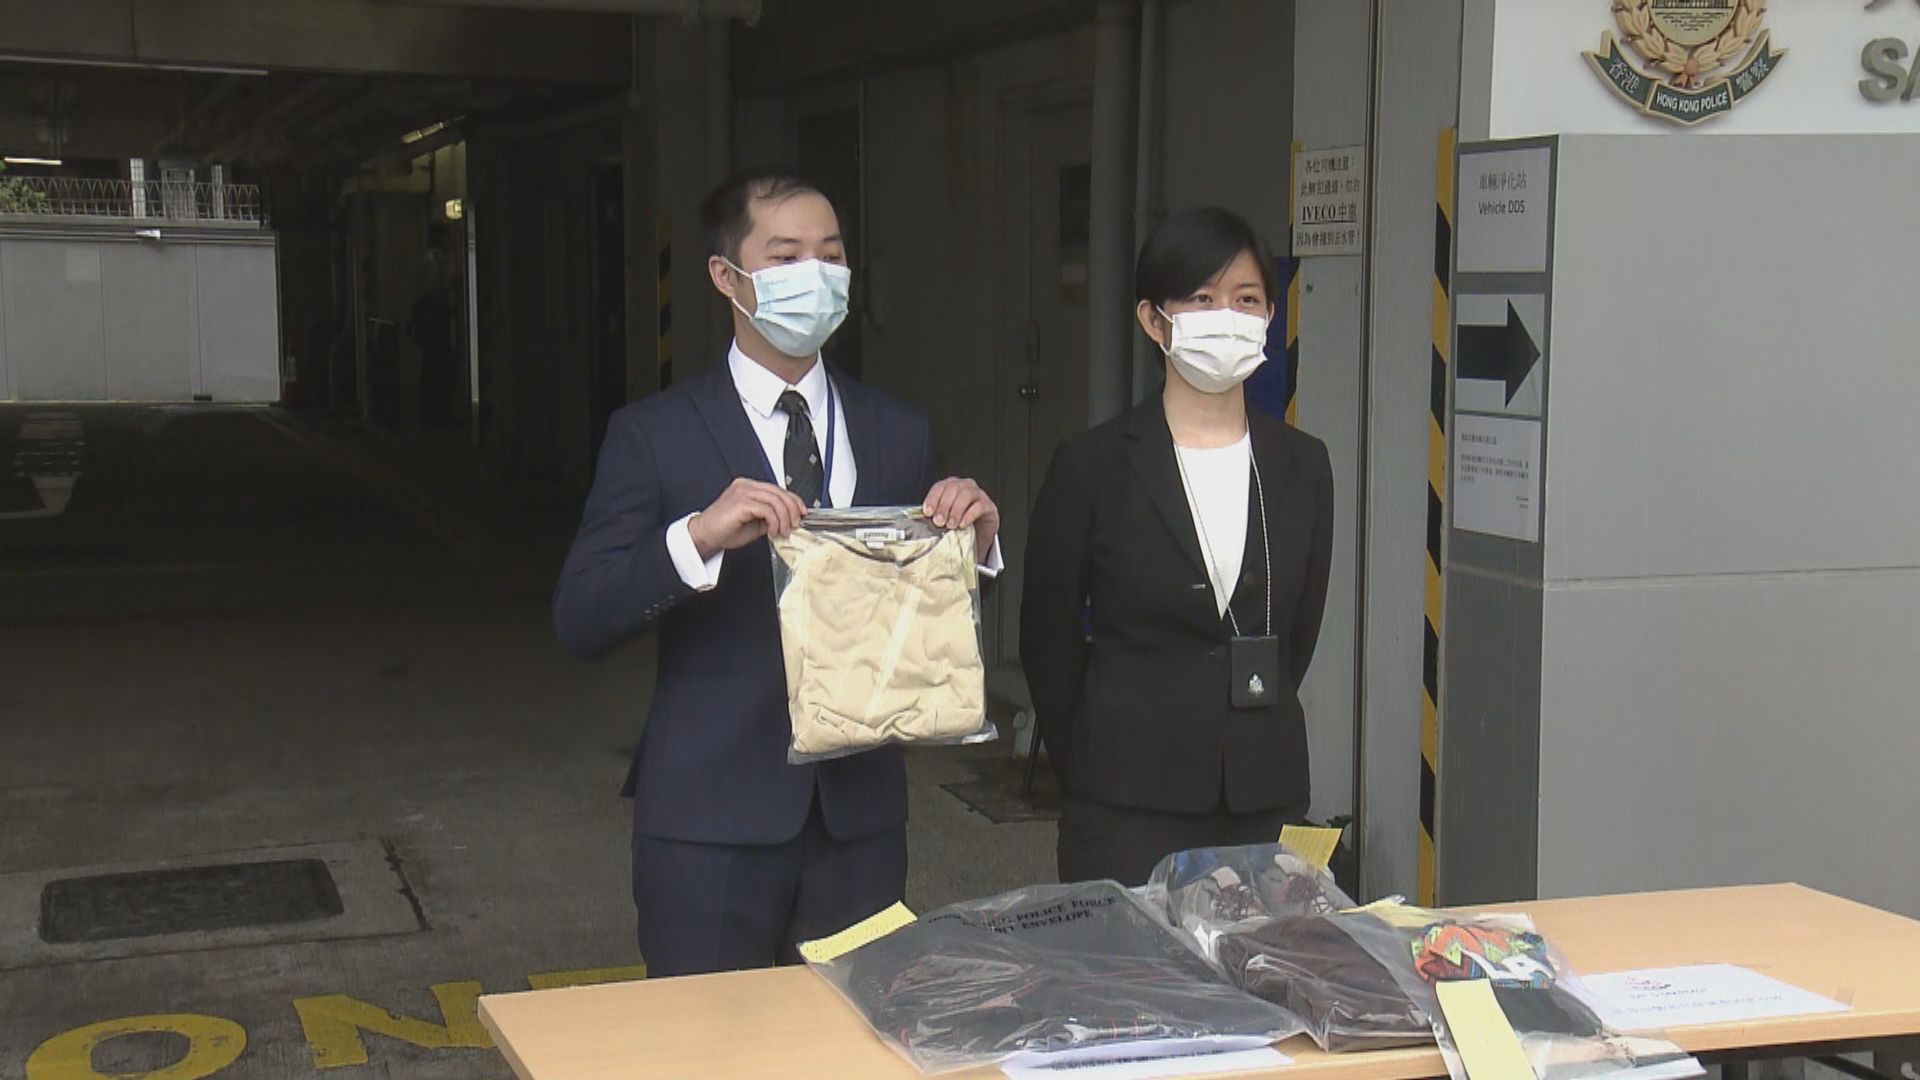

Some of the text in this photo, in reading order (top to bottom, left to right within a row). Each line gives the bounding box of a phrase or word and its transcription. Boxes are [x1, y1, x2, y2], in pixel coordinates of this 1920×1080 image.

[1656, 92, 1728, 113] HONG KONG POLICE
[1302, 204, 1336, 221] IVECO
[1478, 200, 1525, 215] Vehicle DDS
